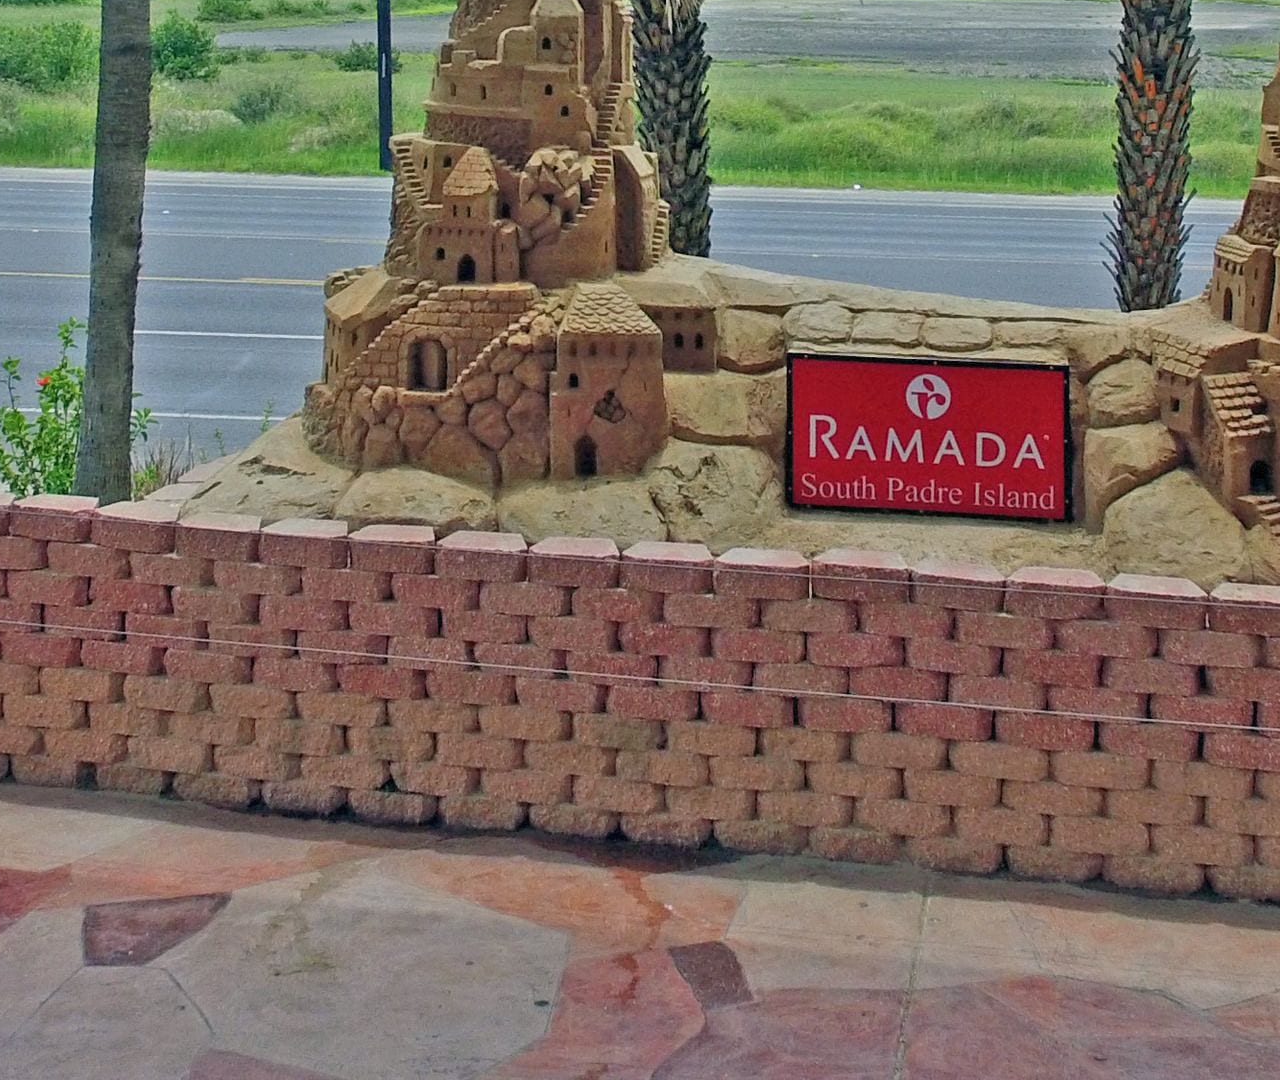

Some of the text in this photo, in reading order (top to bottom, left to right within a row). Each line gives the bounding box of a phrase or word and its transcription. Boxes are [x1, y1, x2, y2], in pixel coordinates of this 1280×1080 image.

[809, 415, 1045, 469] RAMADA
[801, 473, 1055, 510] South Padre Island
